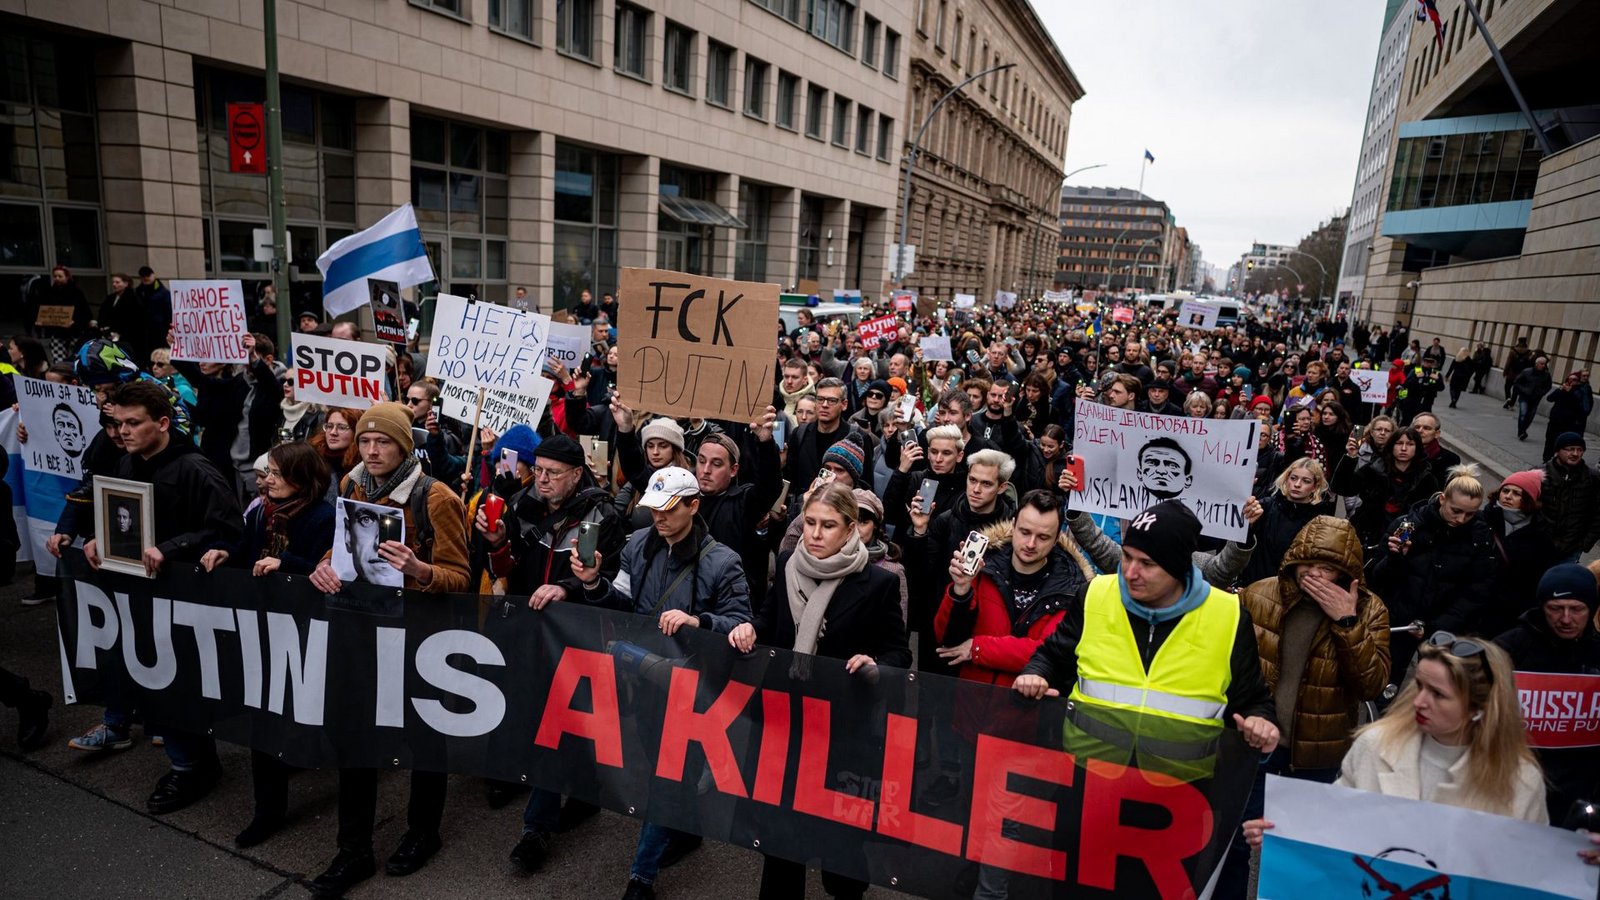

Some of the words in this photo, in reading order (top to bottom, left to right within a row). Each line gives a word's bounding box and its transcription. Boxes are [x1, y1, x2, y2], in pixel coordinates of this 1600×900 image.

[173, 287, 239, 310] ГЛАВНОЕ,
[181, 309, 240, 334] БОЙТЕСЬ
[460, 303, 526, 338] НЕТ
[646, 282, 744, 347] FCK
[860, 316, 896, 336] PUTIN
[377, 325, 396, 335] PUTIN
[863, 331, 897, 348] KRG
[296, 345, 381, 378] STOP
[544, 347, 576, 361] ЕЛО
[298, 368, 380, 401] PUTIN
[439, 360, 466, 378] NO
[474, 364, 520, 389] WAR
[634, 346, 768, 416] PUTIN
[24, 380, 55, 398] ОДИН
[58, 386, 71, 400] ЗА
[77, 388, 100, 409] ВСЕ
[461, 389, 479, 406] СТРА
[1077, 401, 1117, 421] ДАЛЬШЕ
[1119, 412, 1208, 436] ДЕЙСТВОВАТЬ
[1077, 420, 1124, 450] БУДЕМ
[46, 454, 61, 471] ВСЕ
[65, 457, 75, 474] ЗА
[75, 581, 328, 726] PUTIN
[376, 626, 506, 737] IS
[534, 647, 624, 768] A
[655, 667, 1214, 900] KILLER
